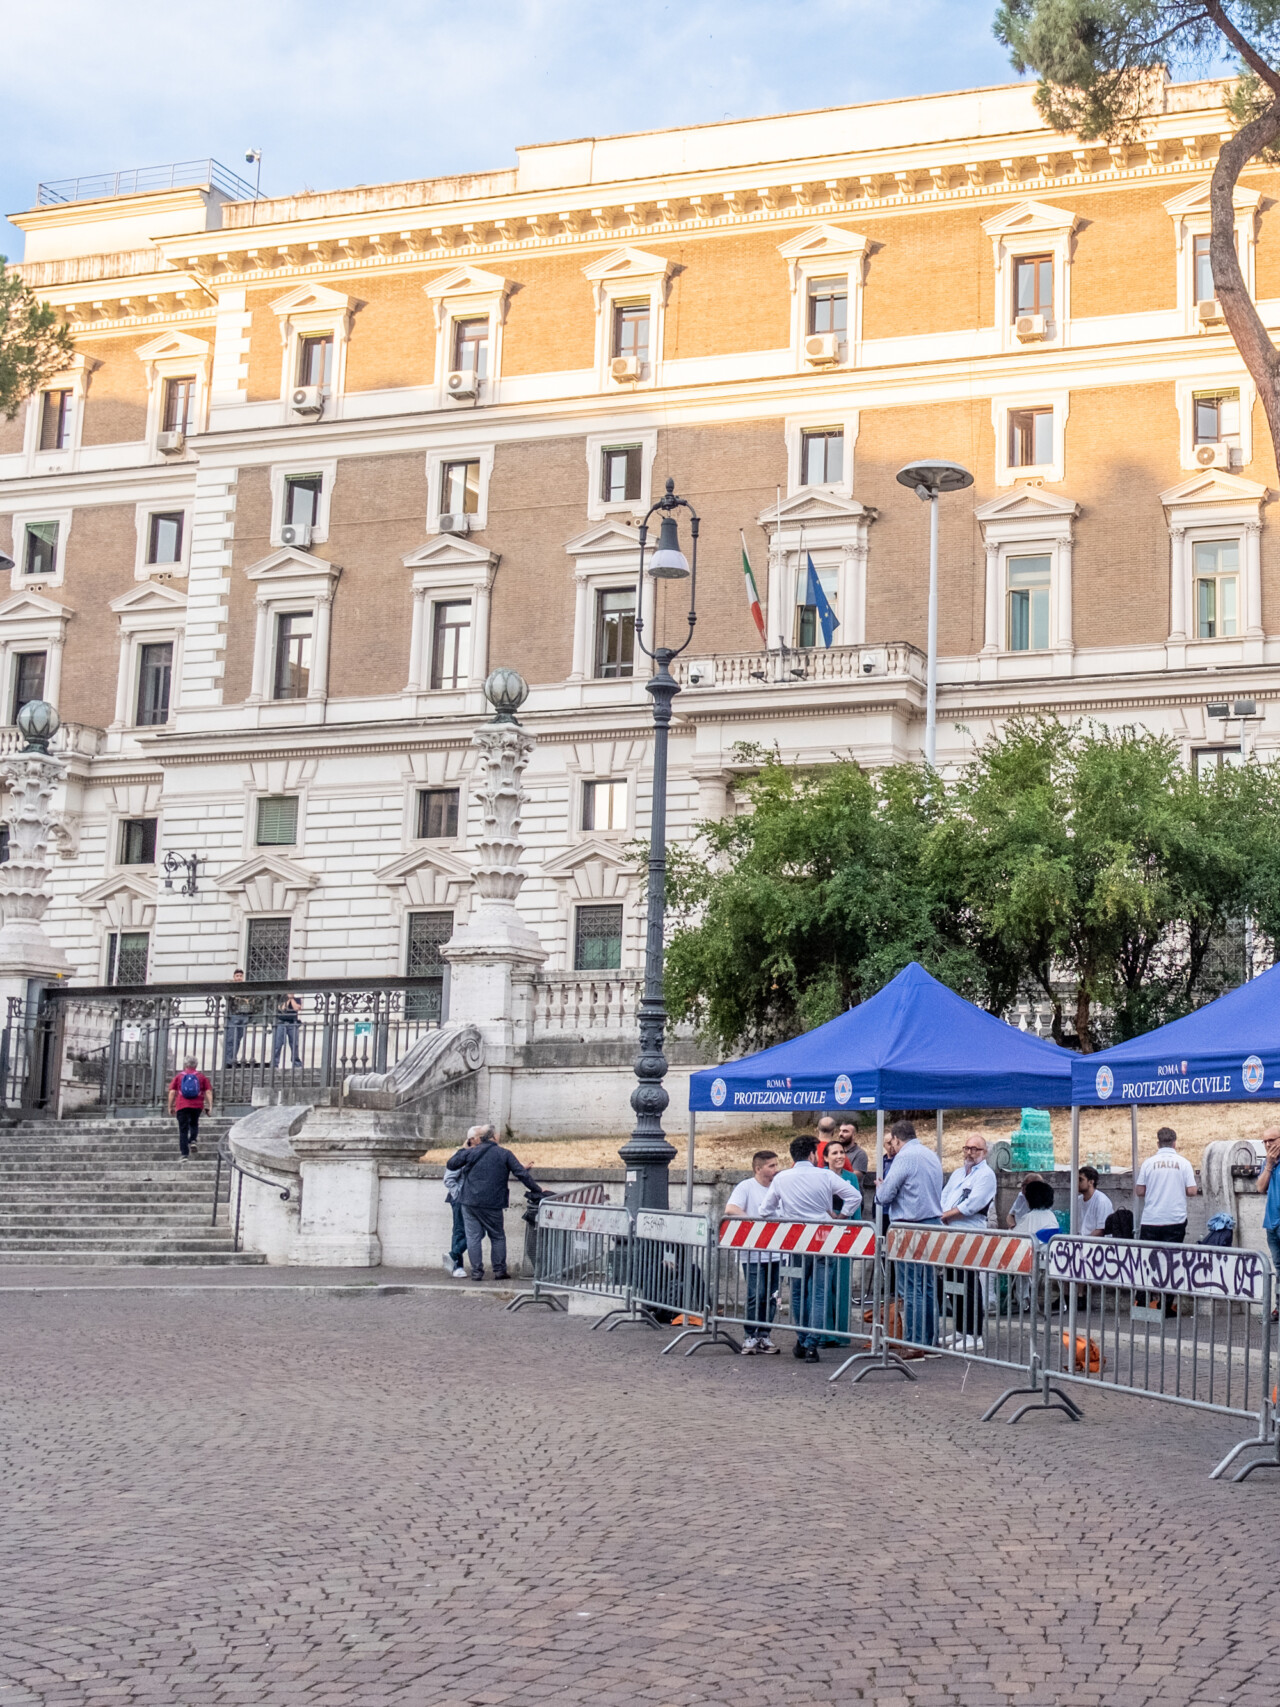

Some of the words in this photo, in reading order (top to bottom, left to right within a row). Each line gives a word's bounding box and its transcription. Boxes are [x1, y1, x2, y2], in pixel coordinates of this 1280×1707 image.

[1157, 1064, 1179, 1076] ROMA
[766, 1079, 785, 1089] ROMA
[1122, 1079, 1190, 1098] PROTEZIONE
[1191, 1075, 1231, 1094] CIVILE
[734, 1091, 792, 1105] PROTEZIONE
[793, 1090, 826, 1104] CIVILE
[1153, 1160, 1180, 1171] ITALIA
